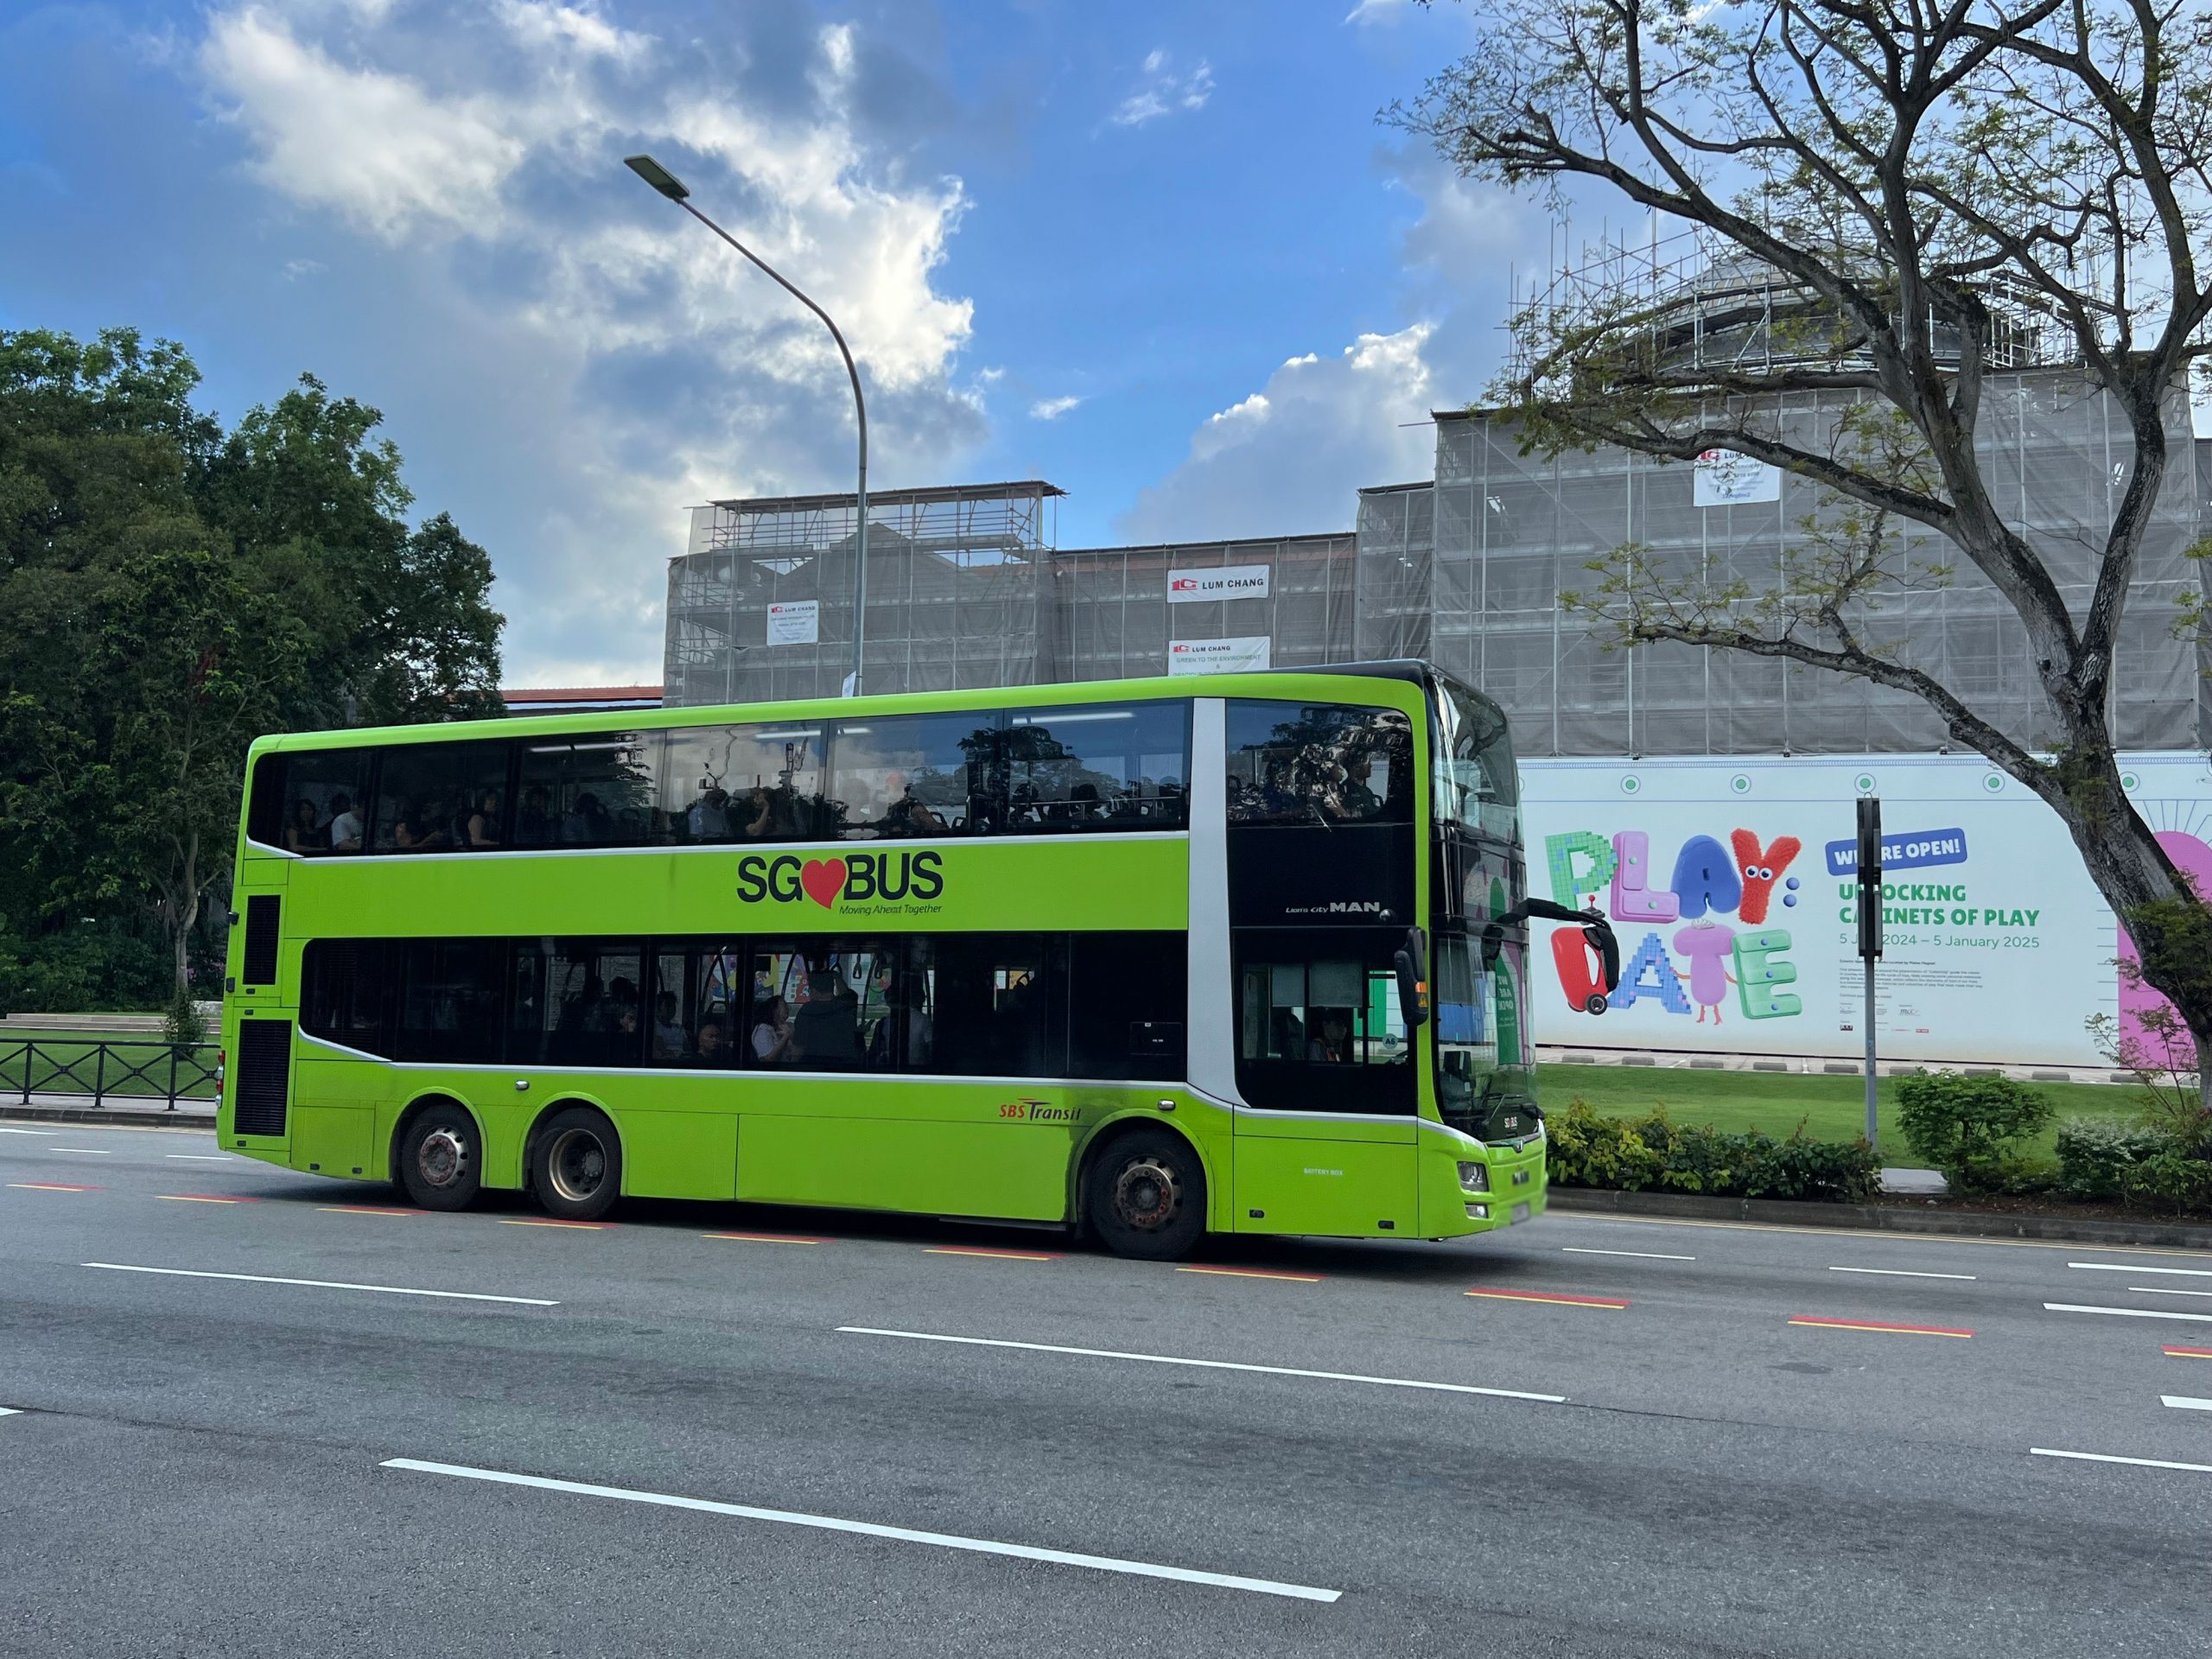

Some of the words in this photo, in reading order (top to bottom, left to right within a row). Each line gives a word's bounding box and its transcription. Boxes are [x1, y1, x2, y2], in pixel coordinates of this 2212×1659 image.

[1202, 581, 1224, 590] LUM
[1227, 578, 1264, 588] CHANG
[1834, 849, 1857, 866] W
[1905, 838, 1961, 858] OPEN!
[843, 851, 944, 900] BUS
[1839, 884, 1967, 901] UOCKING
[839, 906, 871, 915] Moving
[873, 905, 901, 913] Ahead
[904, 904, 942, 915] Together
[1330, 902, 1380, 912] MAN
[1839, 907, 1945, 925] CINETS
[1951, 909, 1978, 925] OF
[1984, 910, 2040, 926] PLAY
[1839, 933, 1847, 944] 5
[1883, 934, 1917, 945] 2024
[1934, 935, 1942, 946] 5
[1946, 935, 1999, 950] January
[2004, 936, 2040, 948] 2025
[1000, 1105, 1026, 1118] SBS
